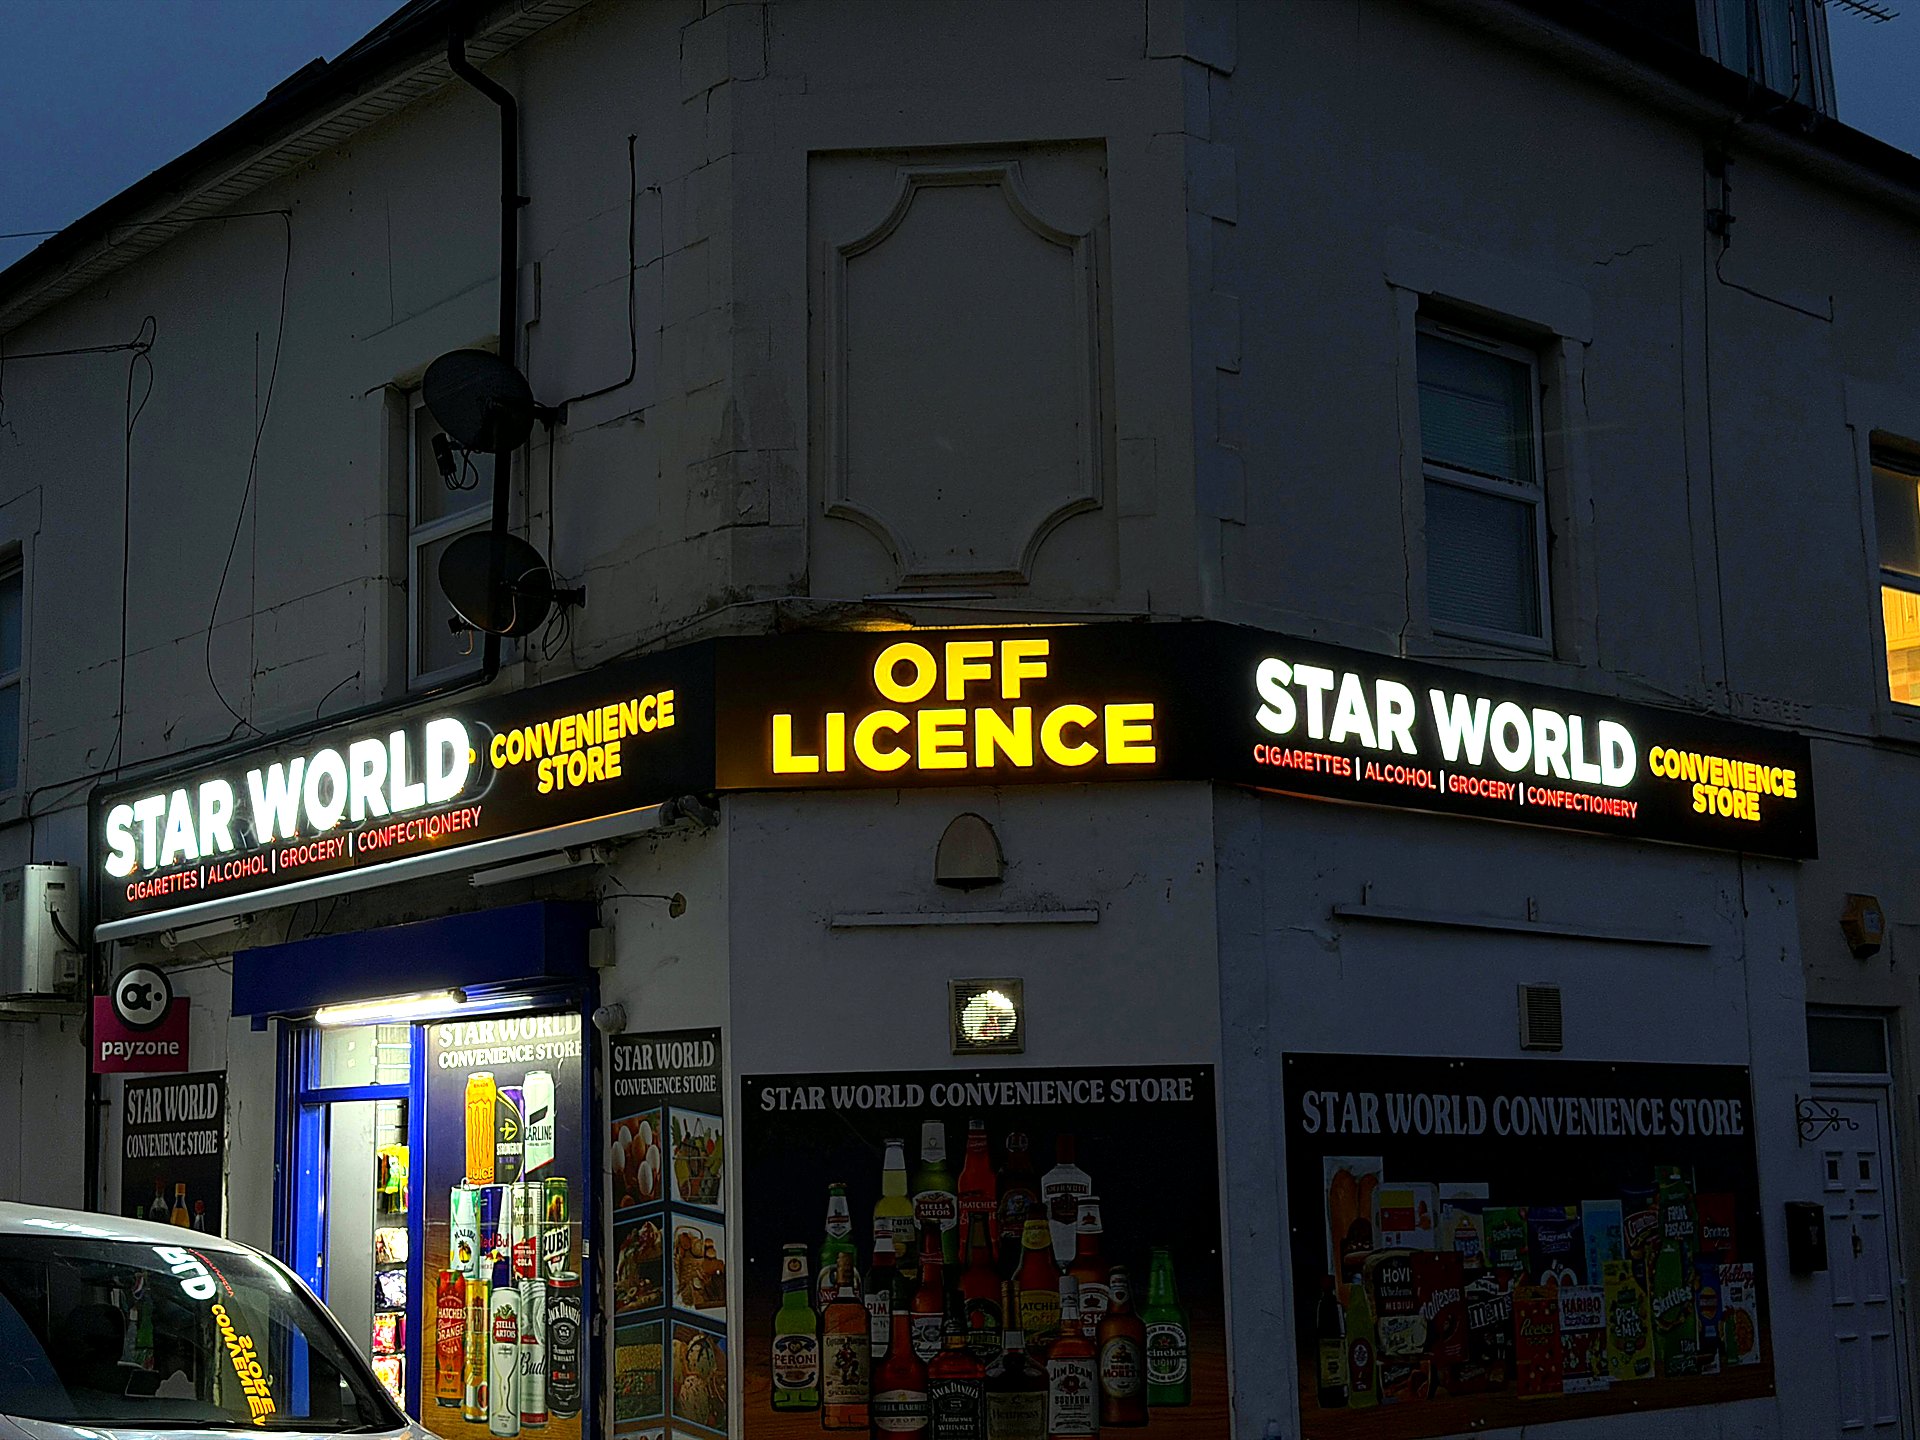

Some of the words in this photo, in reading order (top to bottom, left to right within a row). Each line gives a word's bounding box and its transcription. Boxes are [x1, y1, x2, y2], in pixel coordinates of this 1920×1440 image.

[874, 639, 1049, 702] OFF
[490, 690, 676, 769] CONVENIENCE
[772, 703, 1156, 774] LICENCE
[1254, 657, 1418, 754] STAR
[1429, 688, 1637, 788] WORLD
[537, 741, 622, 795] STORE
[1253, 743, 1351, 777] CIGARETTES
[1364, 761, 1436, 789] ALCOHOL
[1448, 774, 1515, 801] GROCERY
[1527, 786, 1638, 819] CONFECTIONERY
[1649, 746, 1797, 799] CONVENIENCE
[105, 778, 236, 879] STAR
[247, 716, 472, 845] WORLD
[1692, 782, 1761, 821] STORE
[126, 869, 198, 902] CIGARETTES
[207, 852, 269, 886] ALCOHOL
[280, 836, 345, 869] GROCERY
[357, 805, 482, 853] CONFECTIONERY
[438, 1021, 496, 1048] STAR
[498, 1012, 582, 1041] WORLD
[101, 1040, 180, 1061] payzone
[438, 1045, 534, 1069] CONVENIENCE
[535, 1040, 582, 1061] STORE
[614, 1044, 654, 1072] STAR
[656, 1040, 715, 1069] WORLD
[614, 1075, 683, 1096] CONVENIENCE
[683, 1074, 717, 1094] STORE
[760, 1084, 827, 1111] STAR
[831, 1082, 925, 1109] WORLD
[930, 1079, 1105, 1108] CONVENIENCE
[1109, 1077, 1195, 1103] STORE
[127, 1086, 162, 1125] STAR
[164, 1082, 218, 1122] WORLD
[1302, 1090, 1382, 1134] STAR
[1384, 1092, 1487, 1136] WORLD
[1493, 1095, 1667, 1137] CONVENIENCE
[1670, 1097, 1745, 1137] STORE
[126, 1131, 186, 1158] CONVENIENCE
[186, 1129, 218, 1155] STORE
[468, 1167, 493, 1180] JUICE
[1564, 1297, 1601, 1313] HARIBO
[495, 1329, 516, 1339] ARTOIS
[496, 1320, 516, 1330] STELLA
[775, 1354, 817, 1365] PERONI
[1051, 1368, 1067, 1381] JIM
[1069, 1364, 1093, 1381] BEAM
